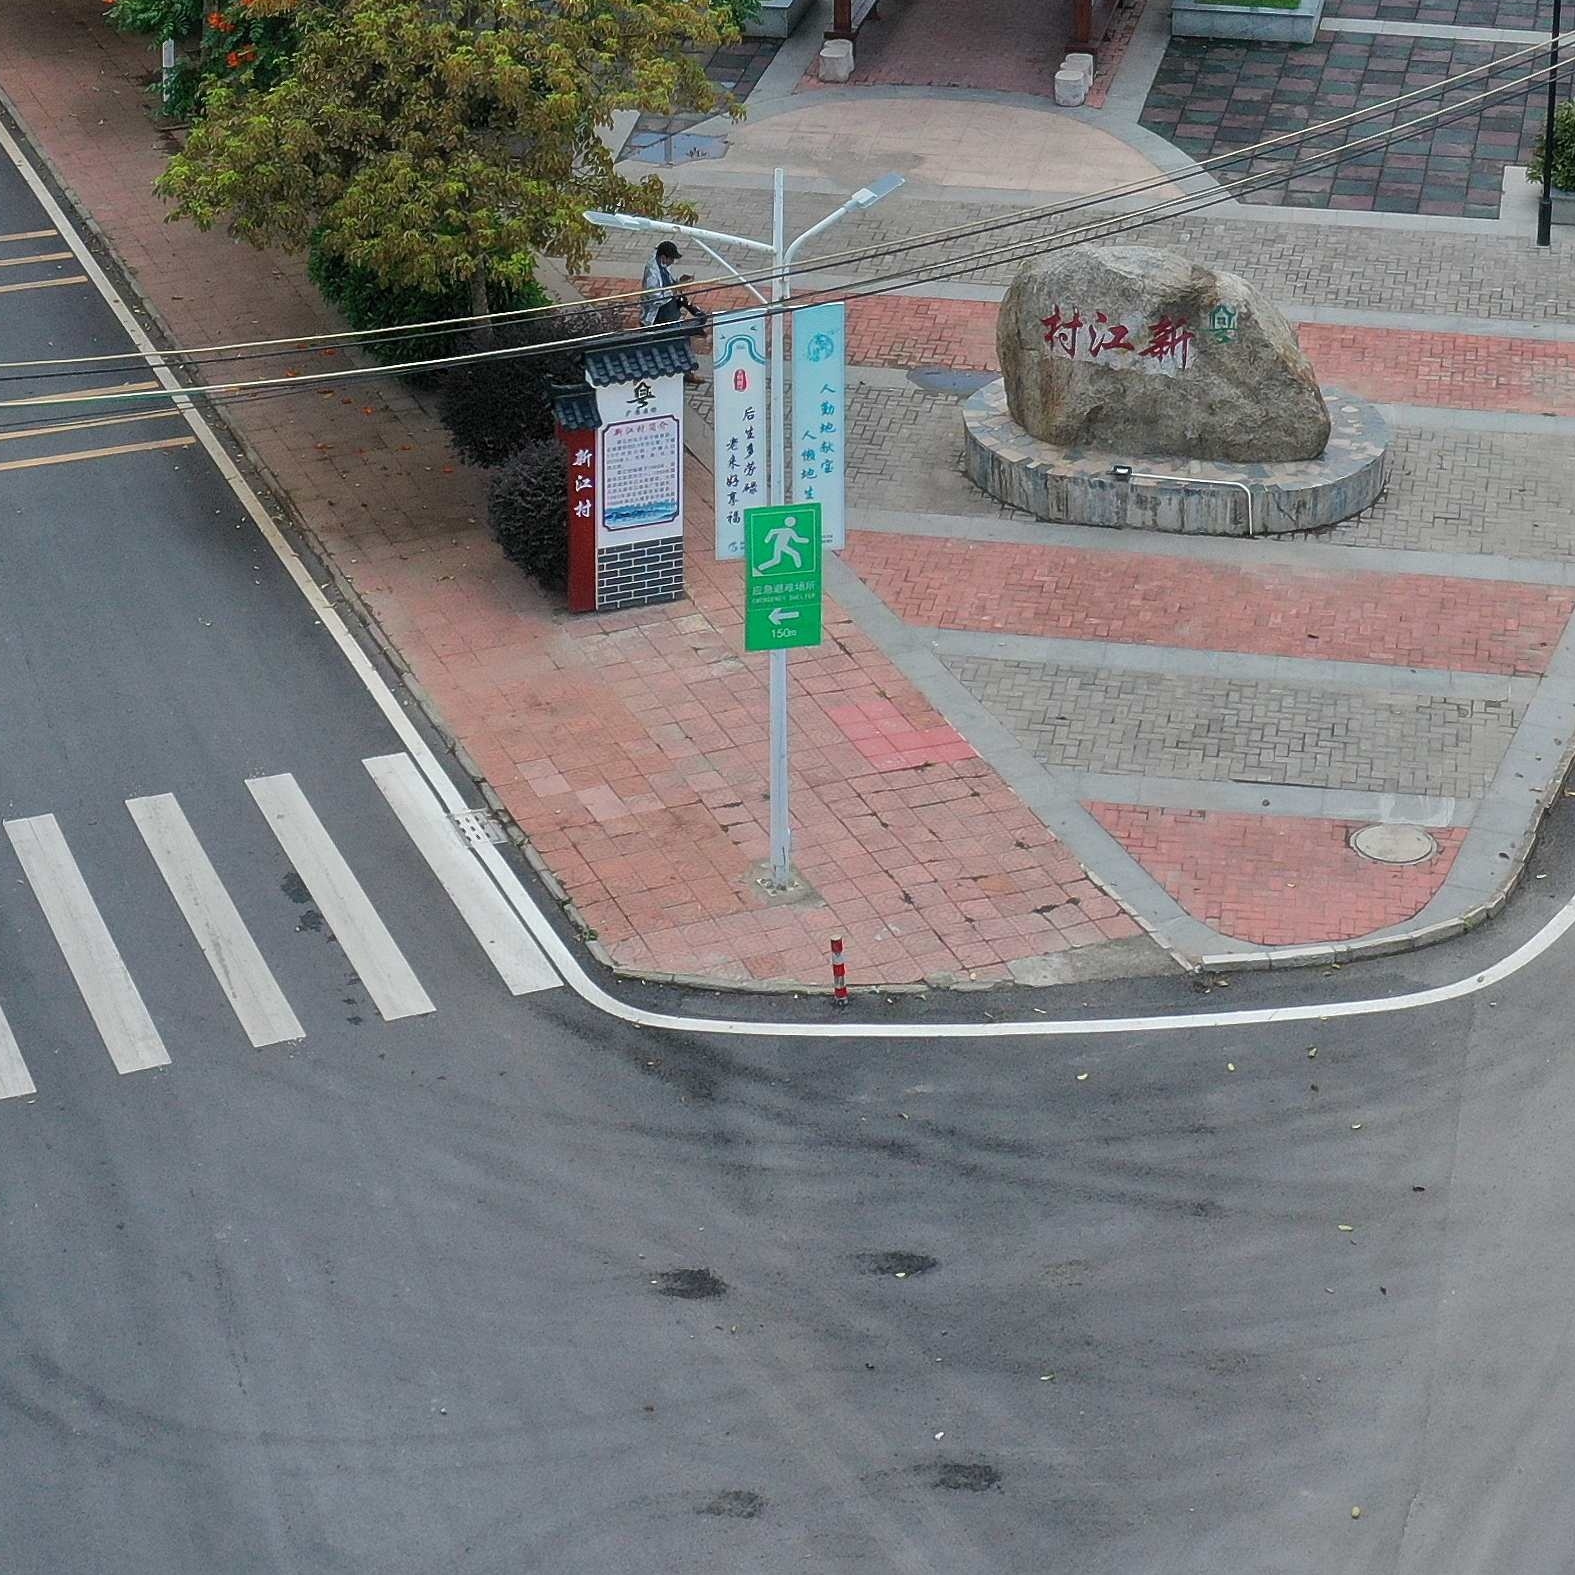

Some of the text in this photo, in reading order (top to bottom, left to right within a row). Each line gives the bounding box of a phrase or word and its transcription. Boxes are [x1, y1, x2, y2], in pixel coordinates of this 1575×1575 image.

[741, 406, 759, 495] 后生多劳碌
[819, 383, 836, 474] 人勤地献宝
[571, 448, 593, 518] 新江村
[725, 436, 742, 524] 老来好享福
[752, 580, 816, 596] 应急避难场所
